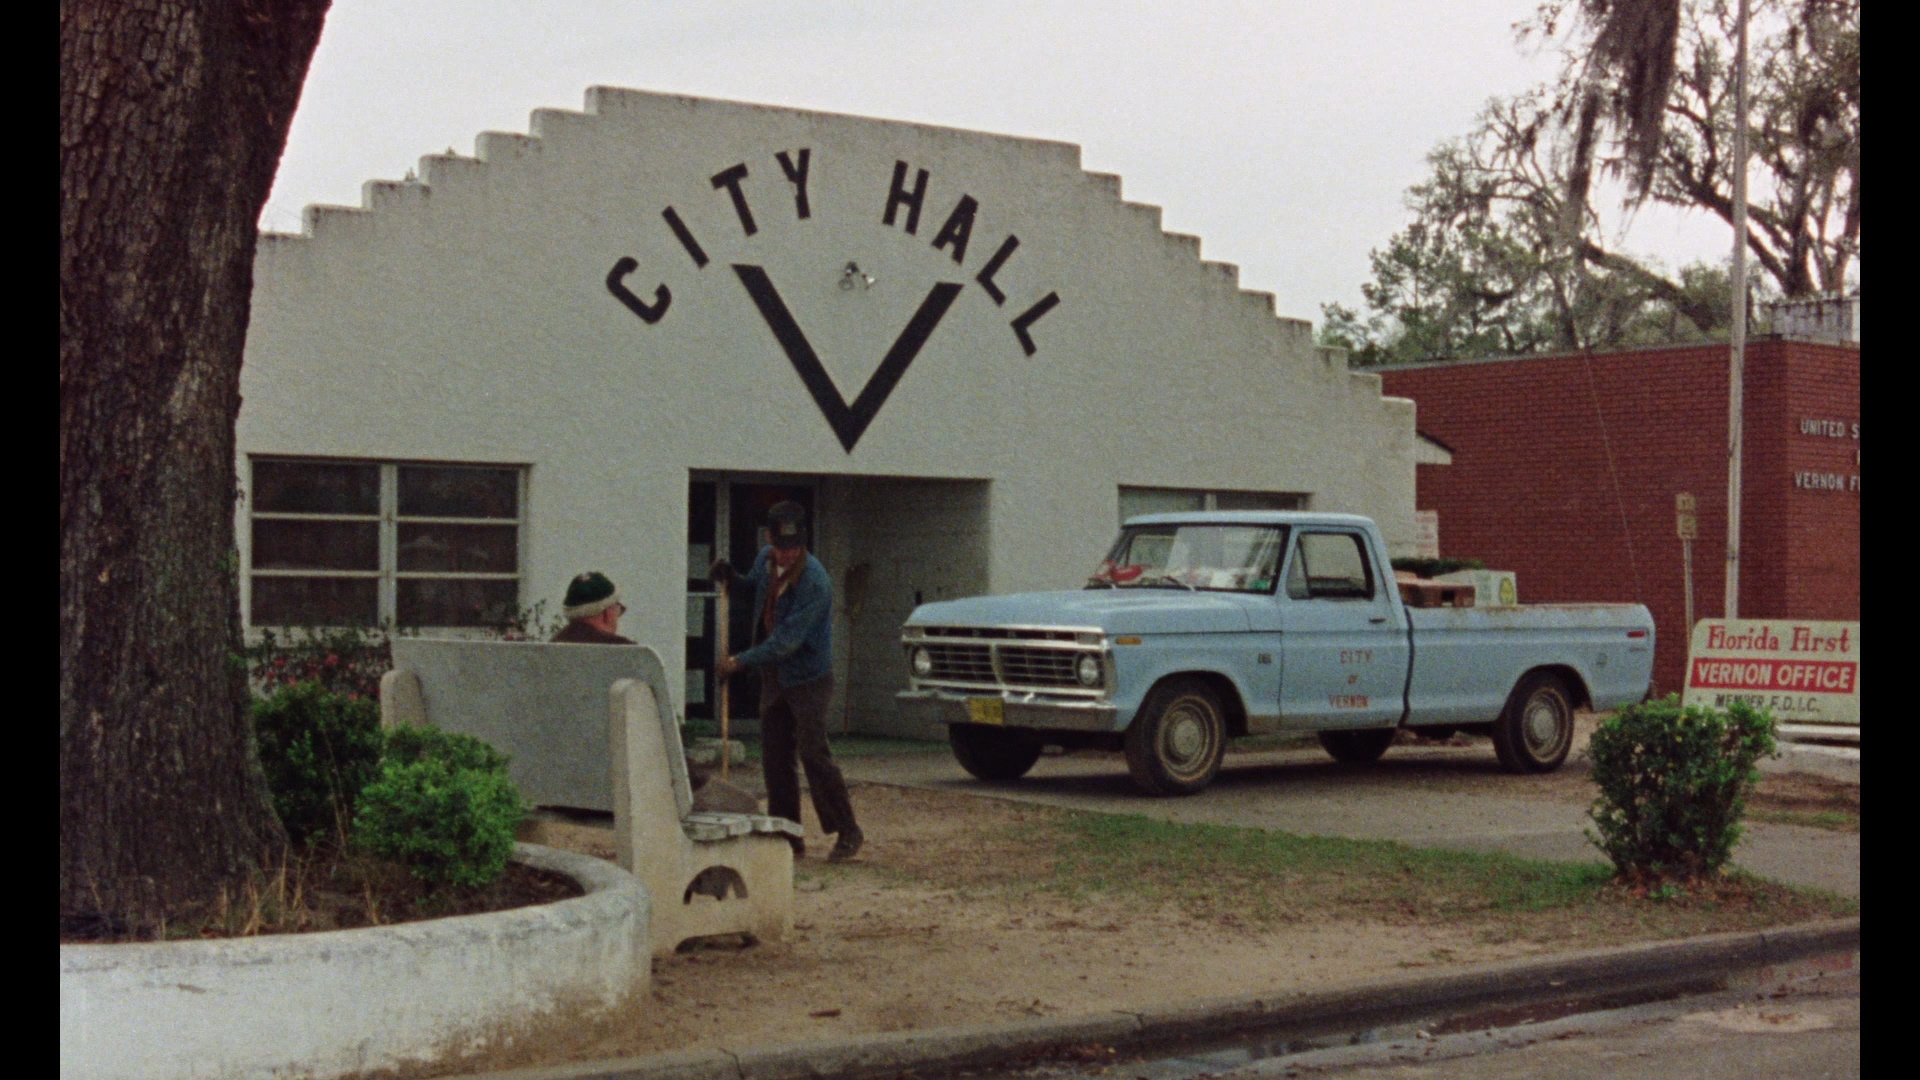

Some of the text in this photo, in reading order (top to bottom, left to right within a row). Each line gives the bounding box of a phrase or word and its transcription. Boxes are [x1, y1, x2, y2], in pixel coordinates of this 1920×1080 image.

[606, 148, 1061, 357] CITY HALL
[731, 263, 964, 454] V
[1800, 418, 1846, 438] UNITED
[1794, 471, 1845, 491] VERNON
[1707, 624, 1851, 653] Florida First
[1340, 650, 1373, 665] CITY
[1697, 662, 1851, 689] VERNON OFFICE
